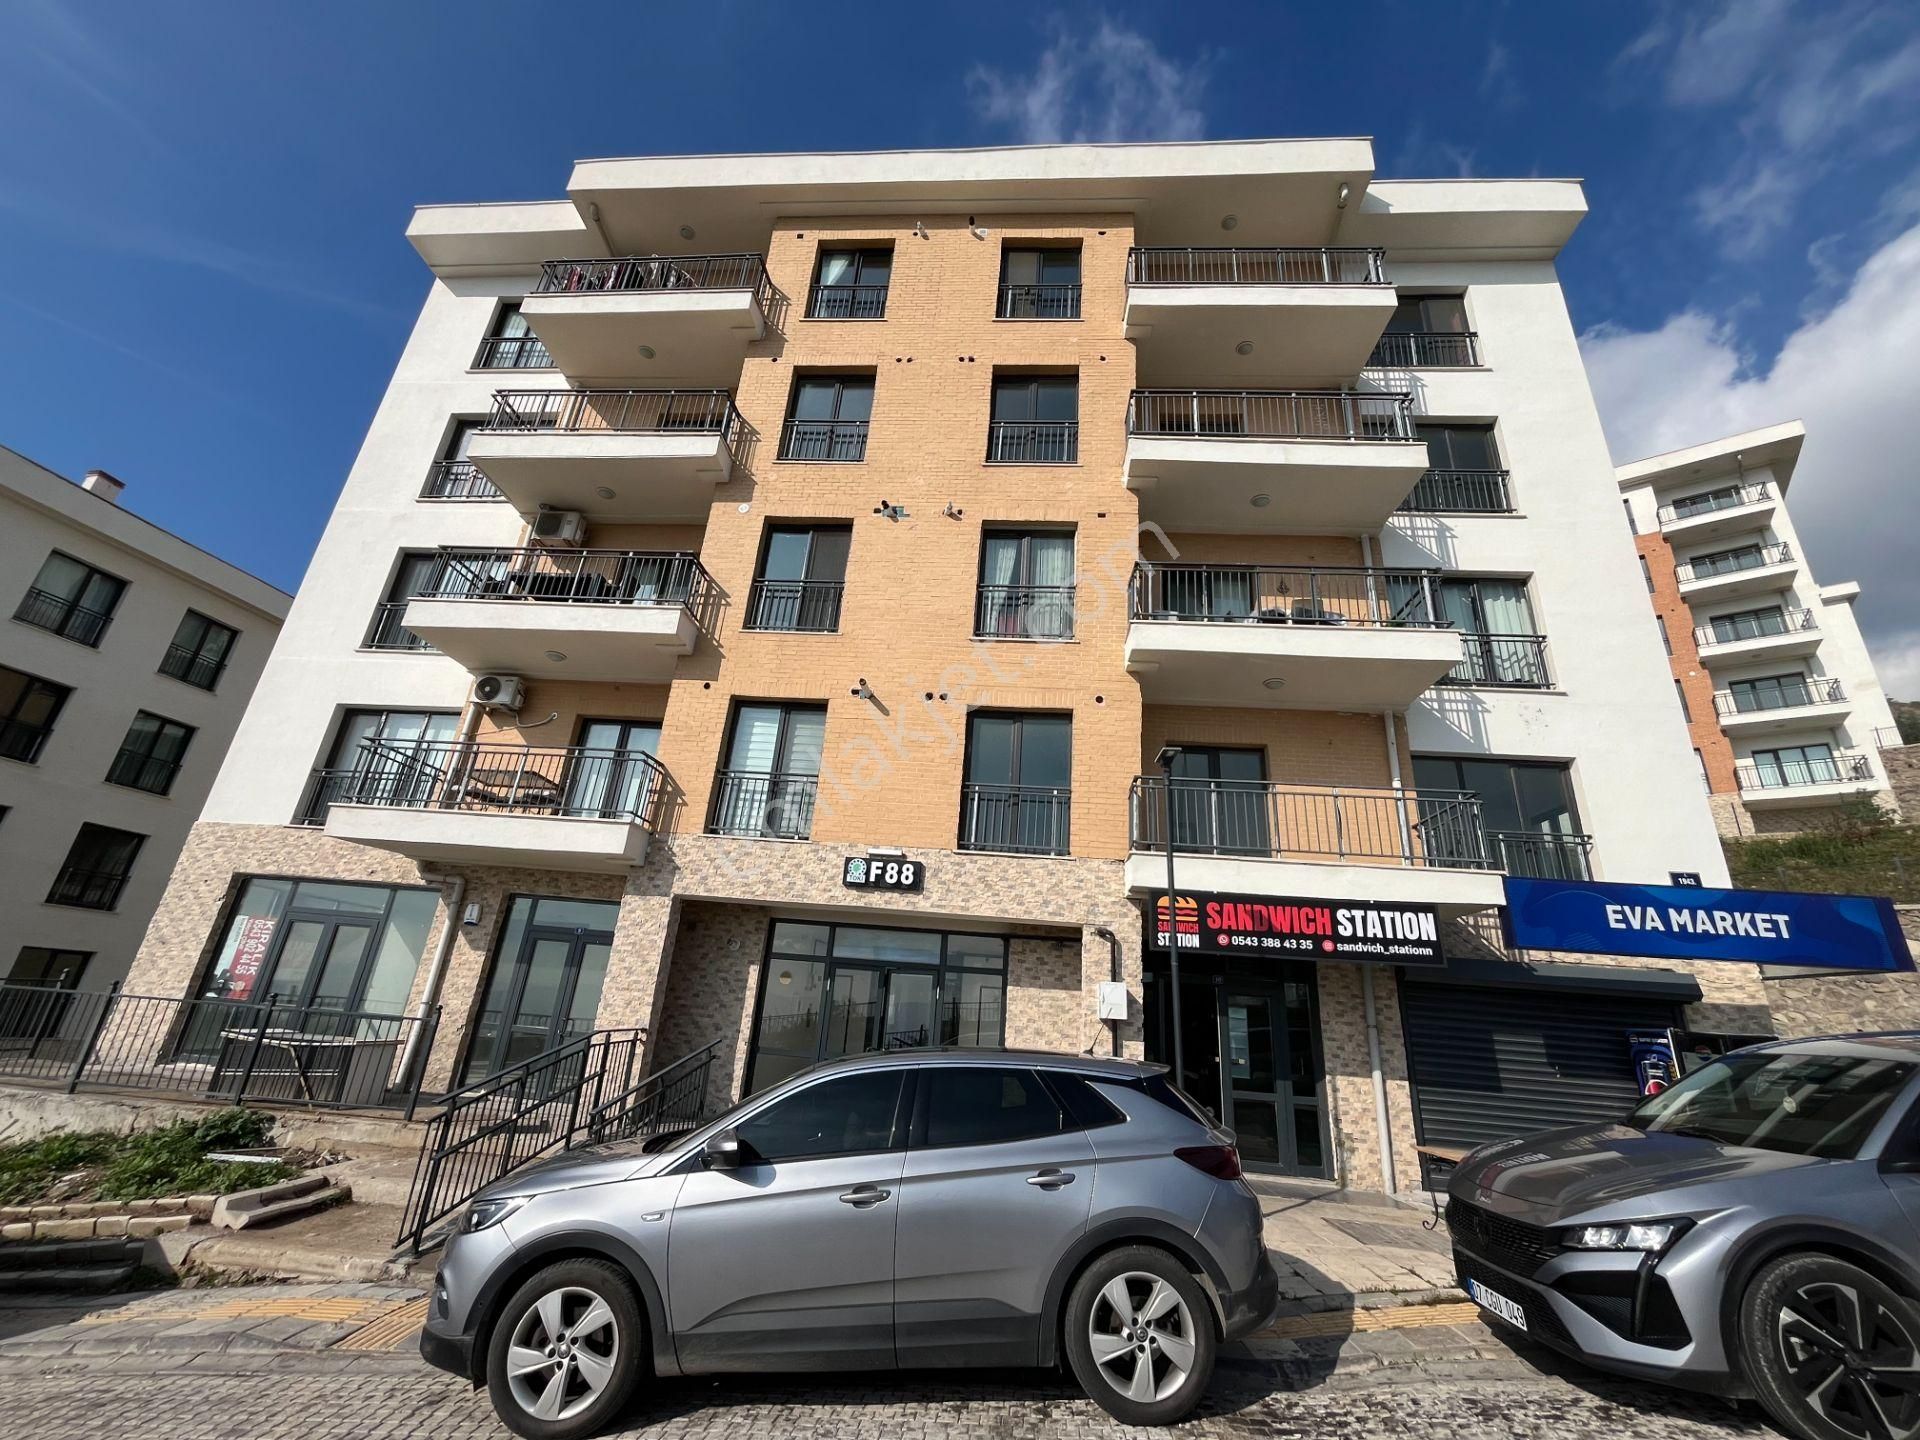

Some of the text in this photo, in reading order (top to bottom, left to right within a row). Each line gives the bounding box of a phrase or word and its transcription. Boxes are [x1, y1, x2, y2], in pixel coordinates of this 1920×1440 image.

[869, 861, 914, 885] F88
[1158, 921, 1199, 933] SAWICH
[1206, 902, 1437, 941] SANDWICH STATION
[1605, 904, 1790, 939] EVA MARKET
[1157, 932, 1200, 948] STTION
[1231, 935, 1313, 950] 0543 388 43 35
[1336, 941, 1433, 956] sandvich_stationn
[1505, 1299, 1525, 1327] 049
